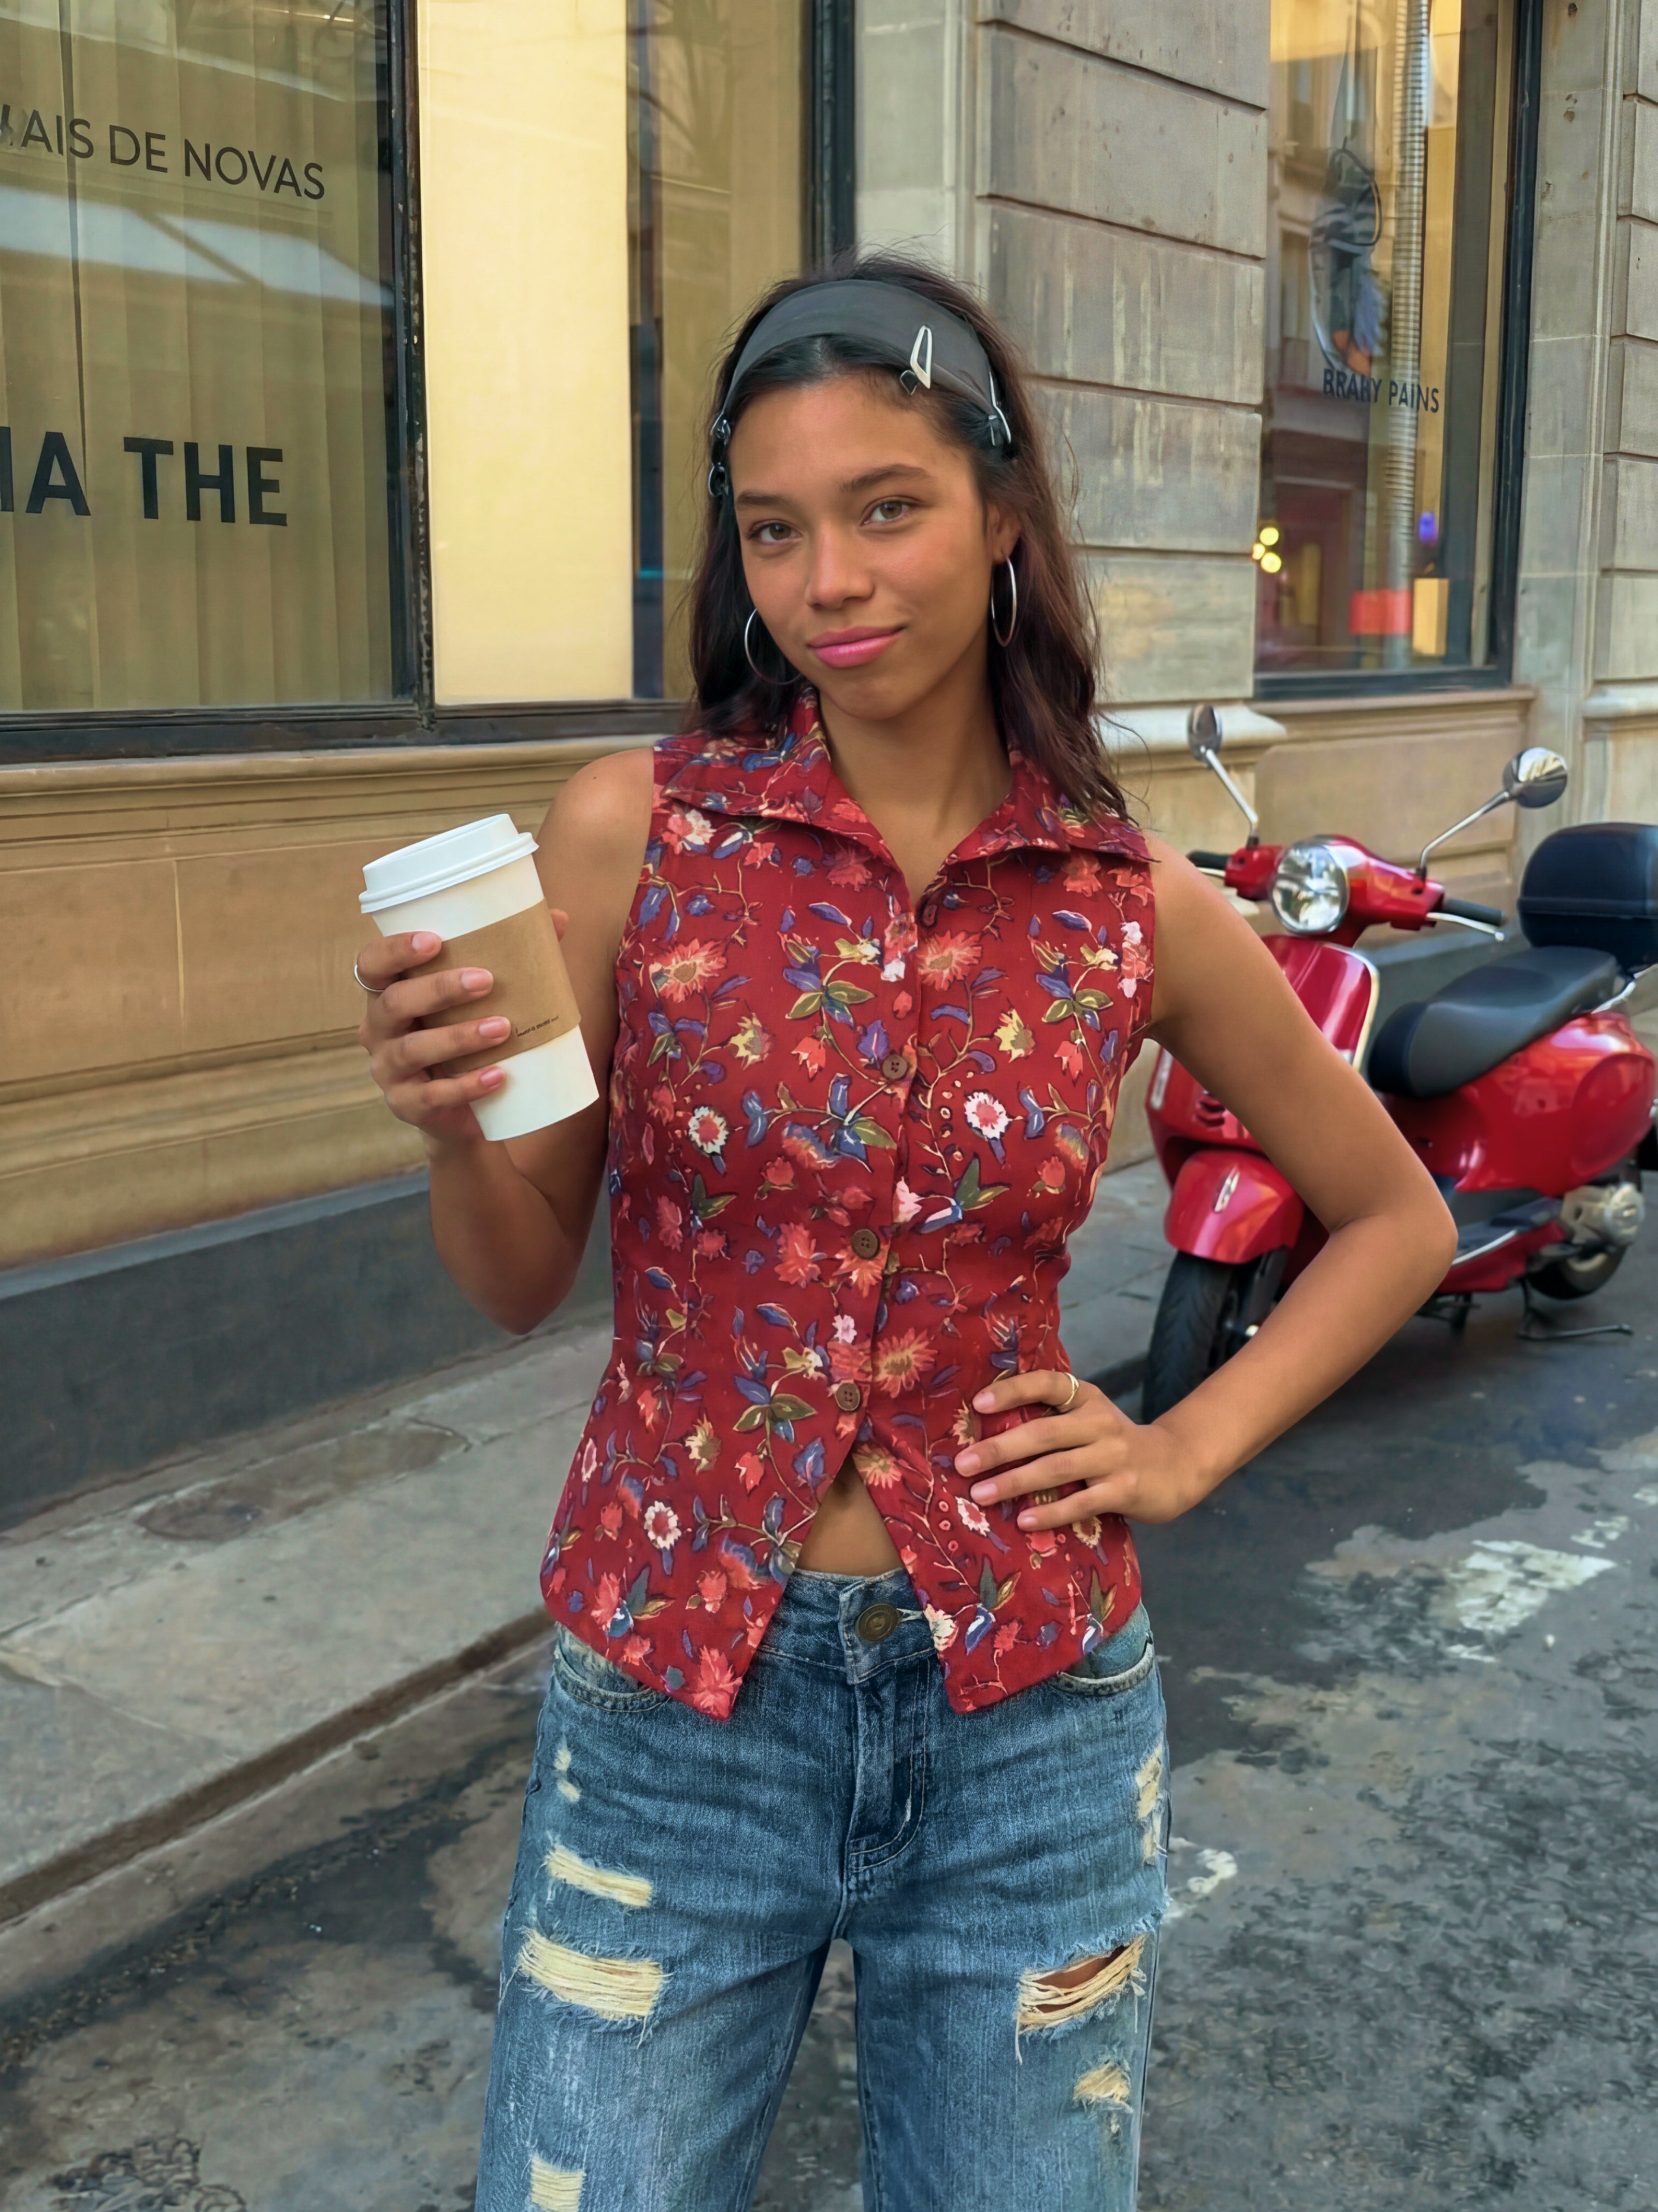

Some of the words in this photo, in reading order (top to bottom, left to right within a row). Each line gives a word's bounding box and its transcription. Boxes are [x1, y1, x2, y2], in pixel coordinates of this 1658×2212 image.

[109, 124, 168, 174] DE
[184, 138, 325, 200] NOVAS
[1389, 379, 1439, 413] PAINS
[123, 437, 288, 526] THE
